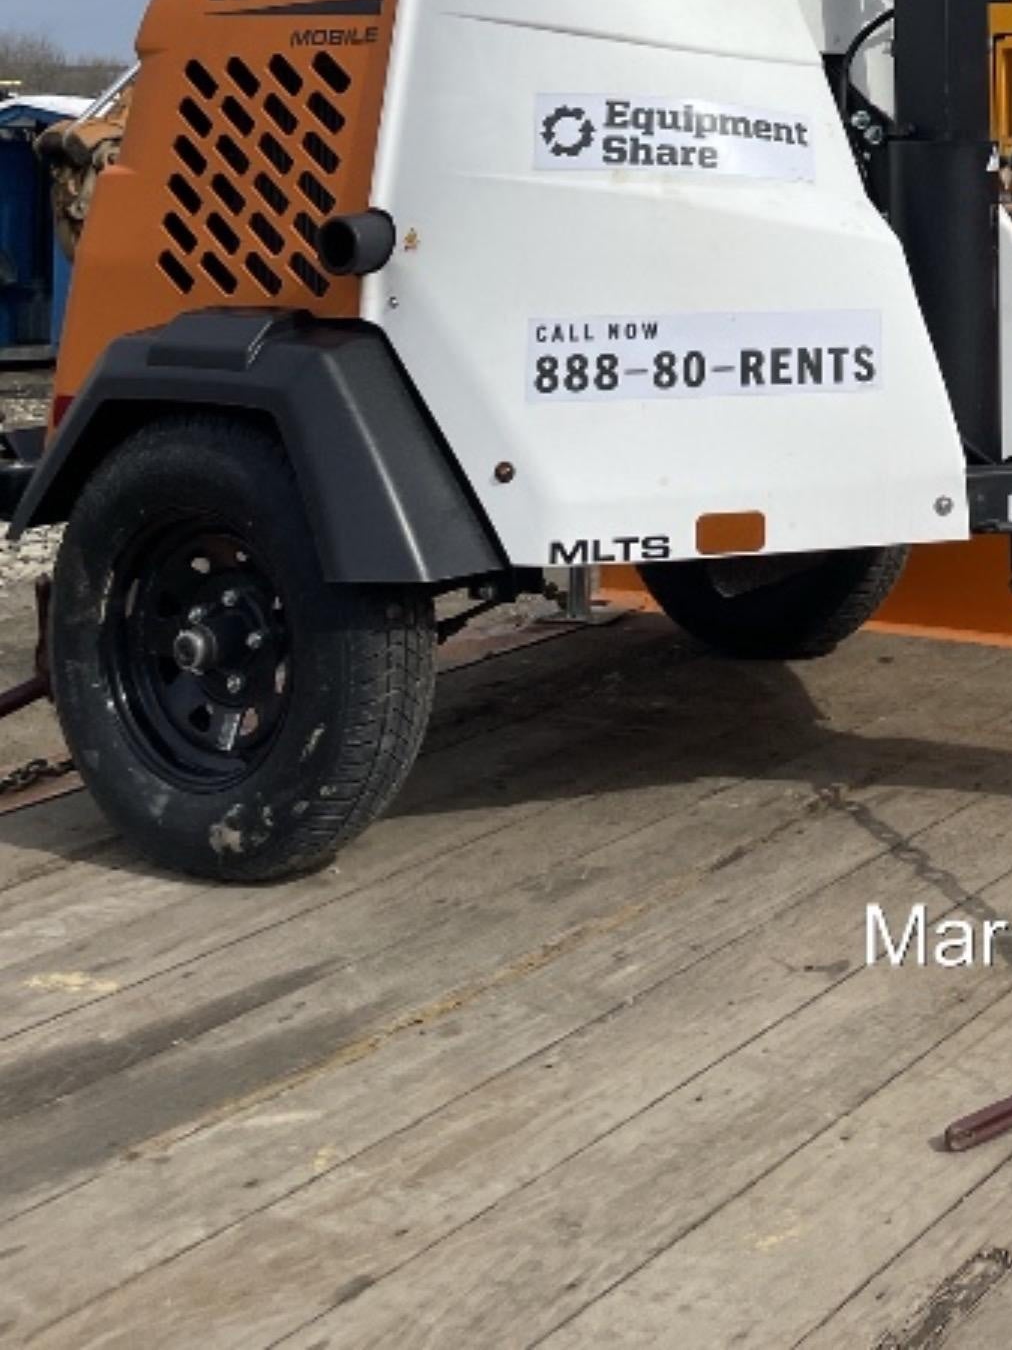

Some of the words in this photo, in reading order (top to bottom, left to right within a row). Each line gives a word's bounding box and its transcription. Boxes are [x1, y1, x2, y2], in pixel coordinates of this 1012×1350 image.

[290, 26, 379, 47] MOBILE
[602, 99, 809, 148] Equipment
[602, 134, 718, 168] Share
[535, 324, 595, 343] CALL
[607, 321, 659, 341] NOW
[533, 345, 876, 394] 888-80-RENTS
[549, 535, 670, 564] MLTS
